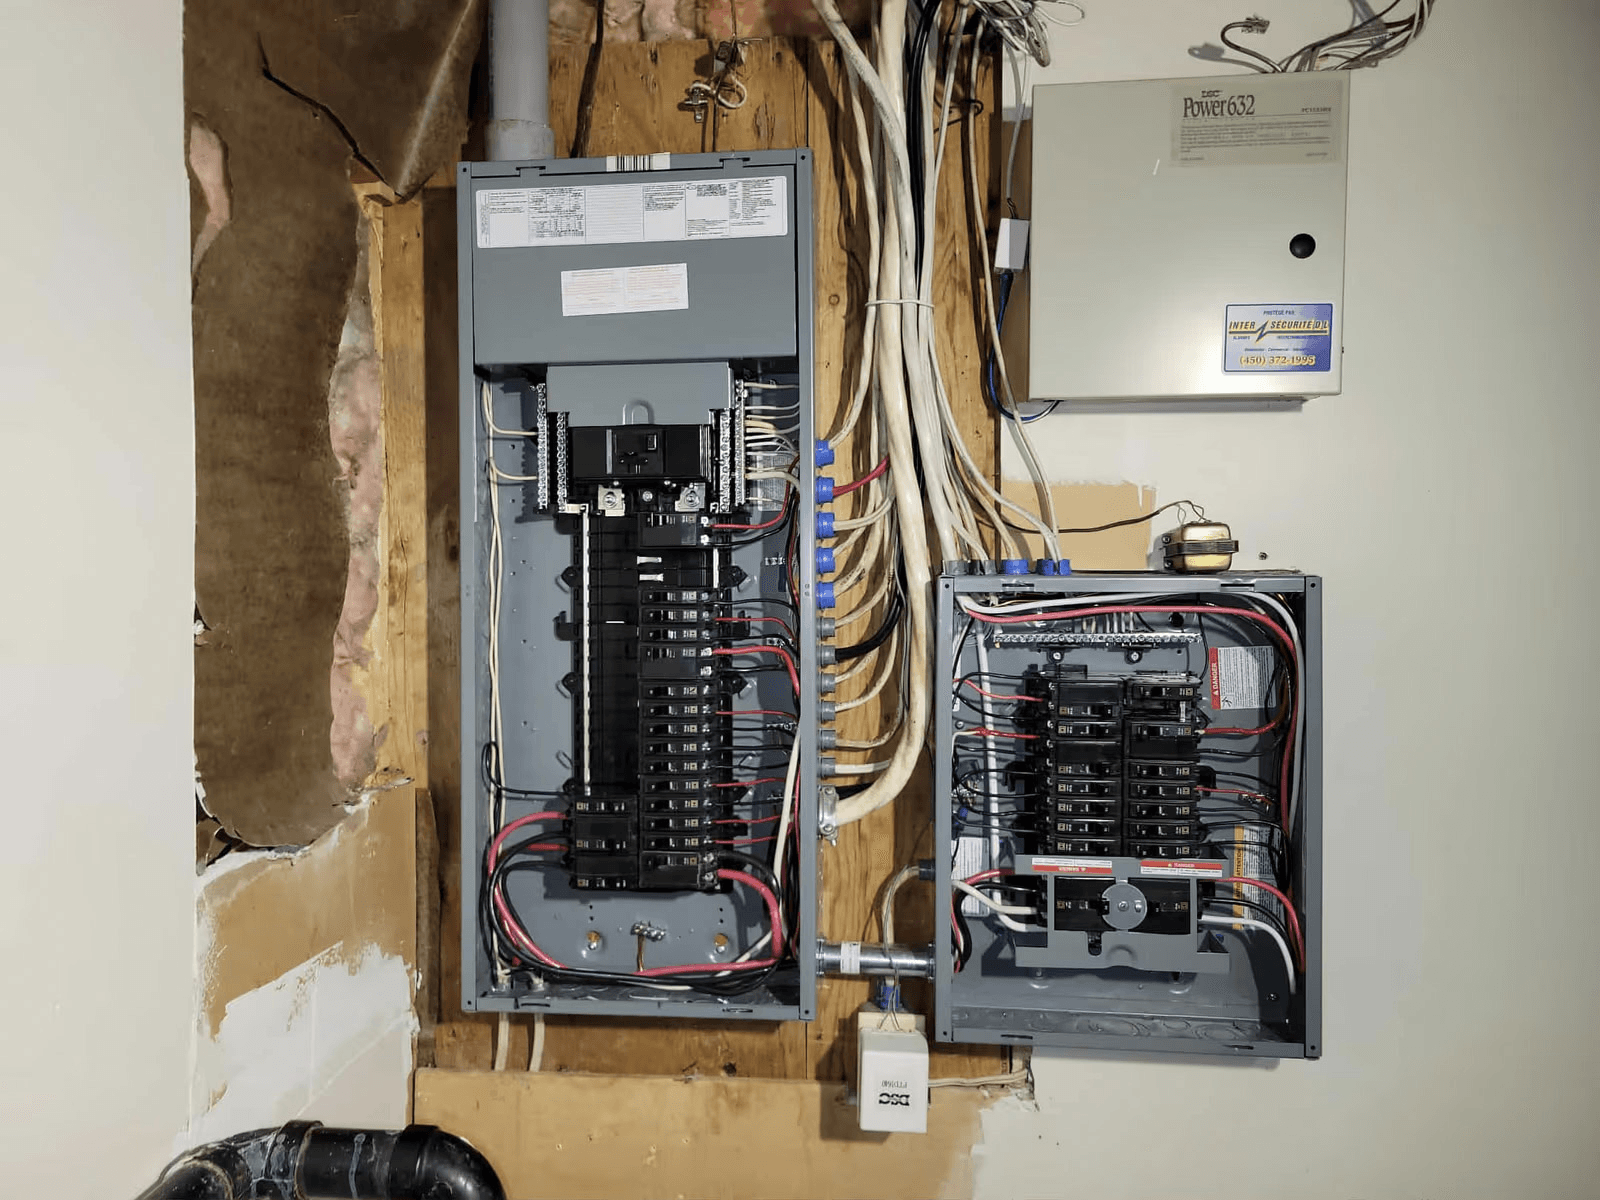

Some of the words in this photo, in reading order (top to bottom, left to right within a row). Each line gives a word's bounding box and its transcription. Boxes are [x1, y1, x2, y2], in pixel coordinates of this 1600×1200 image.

[1229, 321, 1256, 330] INTER
[1240, 355, 1266, 366] (450)
[1268, 355, 1316, 366] 372-1995
[879, 1092, 910, 1106] DSC
